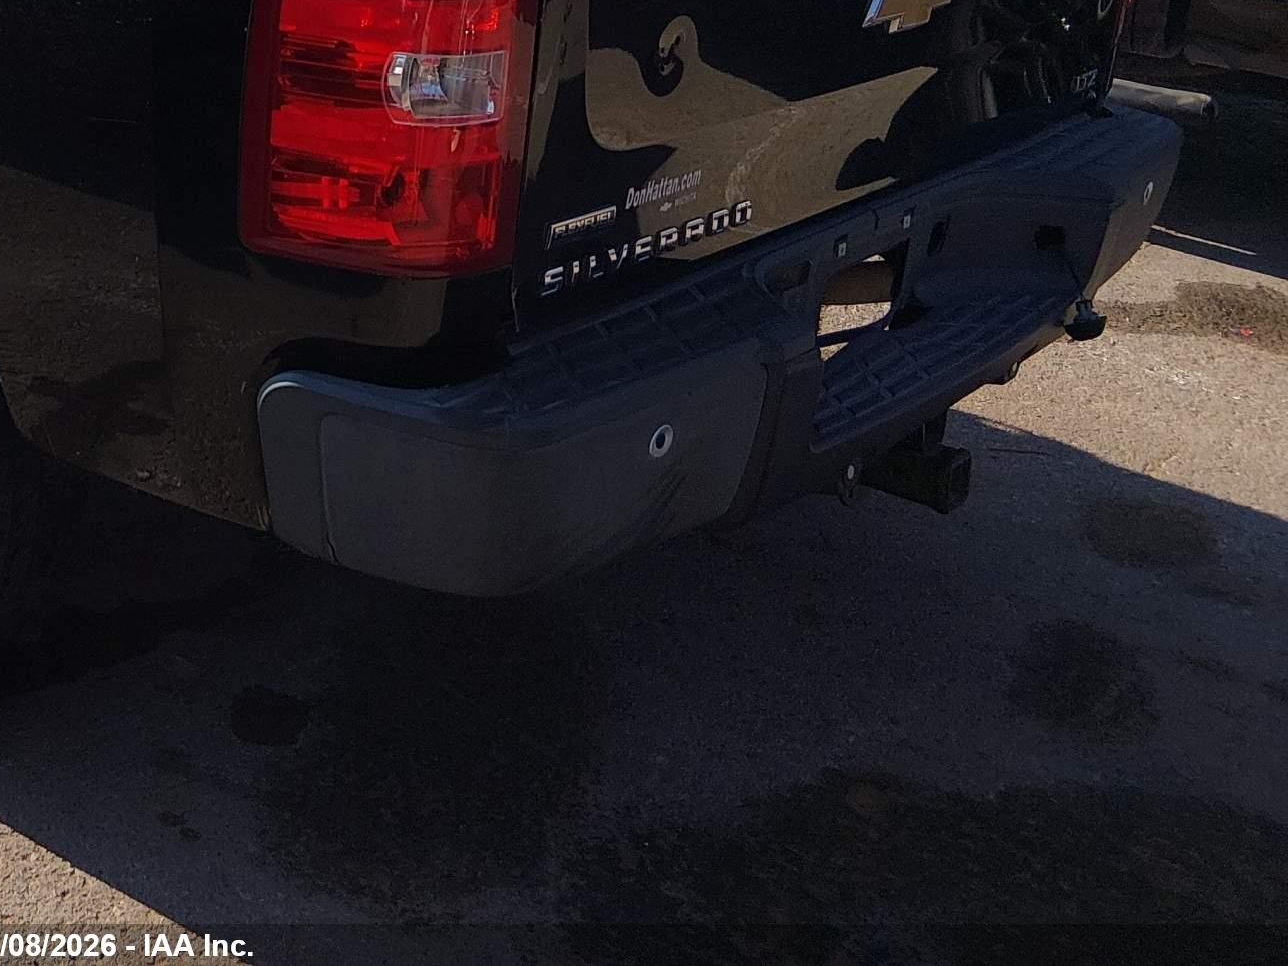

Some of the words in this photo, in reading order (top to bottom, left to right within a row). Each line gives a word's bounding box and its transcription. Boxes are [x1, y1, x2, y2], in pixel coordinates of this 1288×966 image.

[624, 169, 702, 210] DonHattan.com
[552, 209, 613, 240] FLEXFUEL
[539, 199, 753, 297] SILVERADO
